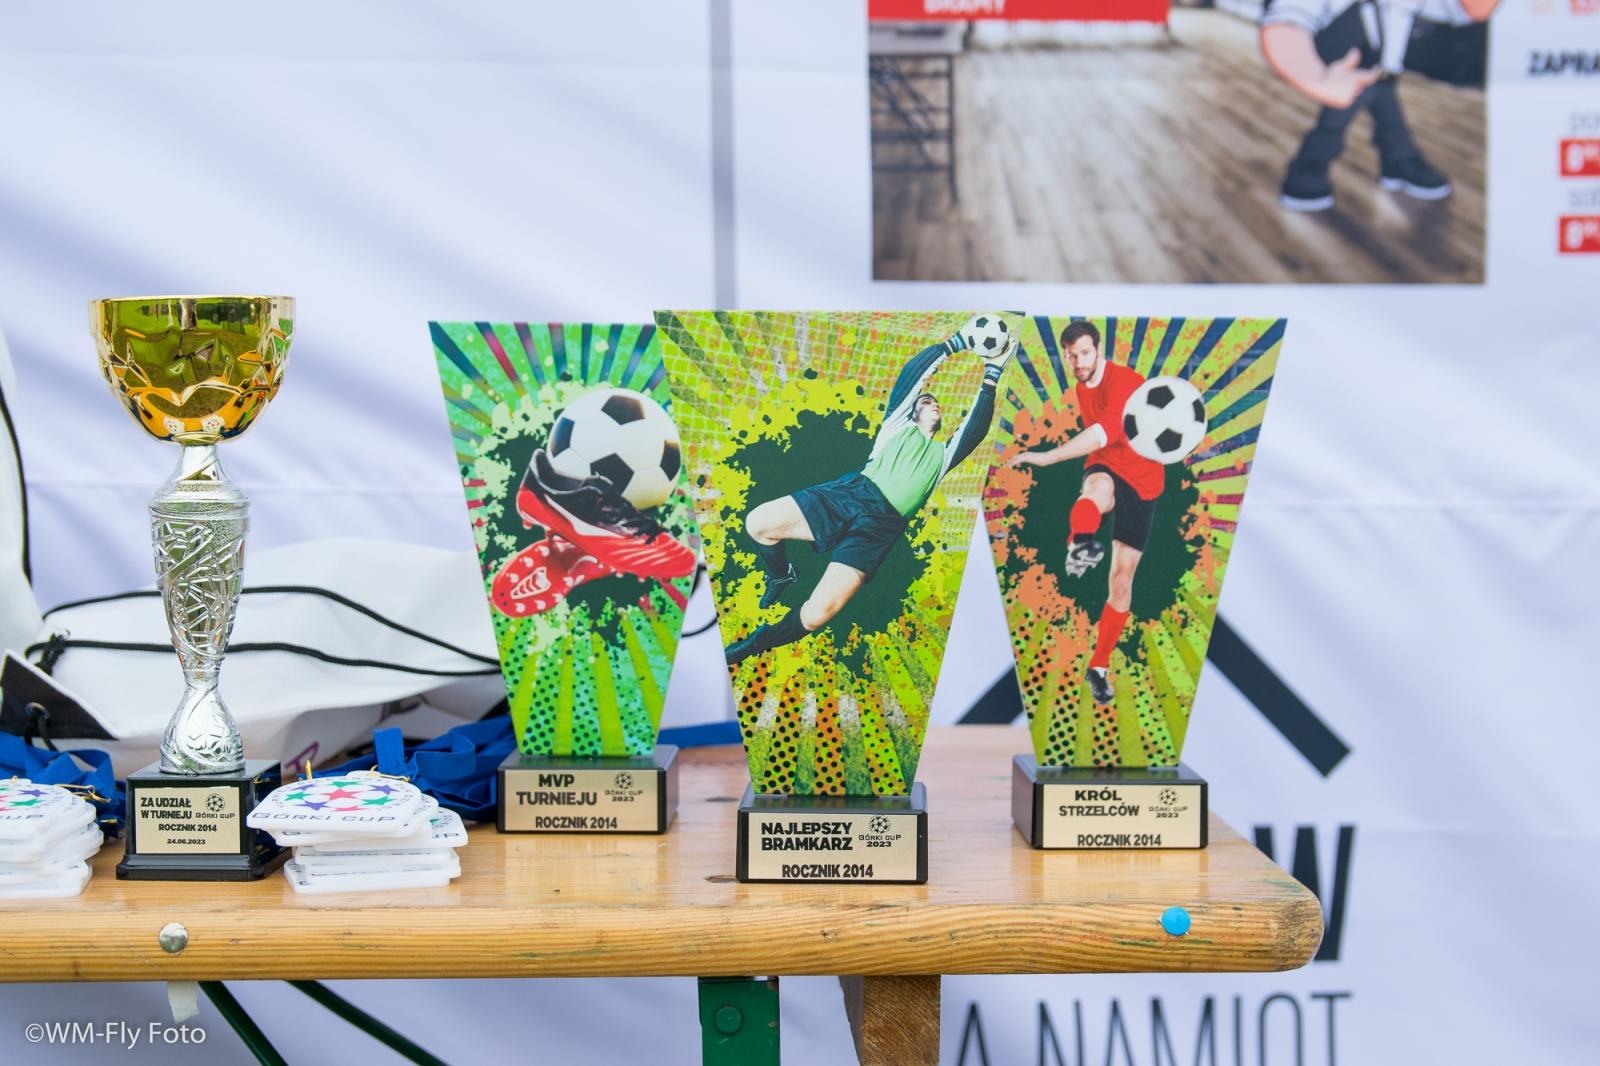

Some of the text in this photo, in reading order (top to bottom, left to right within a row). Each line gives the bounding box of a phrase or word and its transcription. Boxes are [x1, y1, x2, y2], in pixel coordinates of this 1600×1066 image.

[538, 774, 575, 787] MVP
[516, 791, 598, 806] TURNIEJU
[1074, 787, 1122, 801] KRÓL
[140, 797, 192, 808] ZA UDZIAŁ
[1058, 802, 1140, 816] STRZELCÓW
[140, 810, 192, 819] W TURNIEJU
[158, 824, 217, 832] ROCZNIK 2014
[535, 816, 618, 828] ROCZNIK 2014
[761, 822, 853, 835] NAJLEPSZY
[761, 837, 853, 850] BRAMKARZ
[858, 833, 883, 841] GÓRKI
[1077, 834, 1162, 846] ROCZNIK 2014
[781, 864, 874, 878] ROCZNIK 2014
